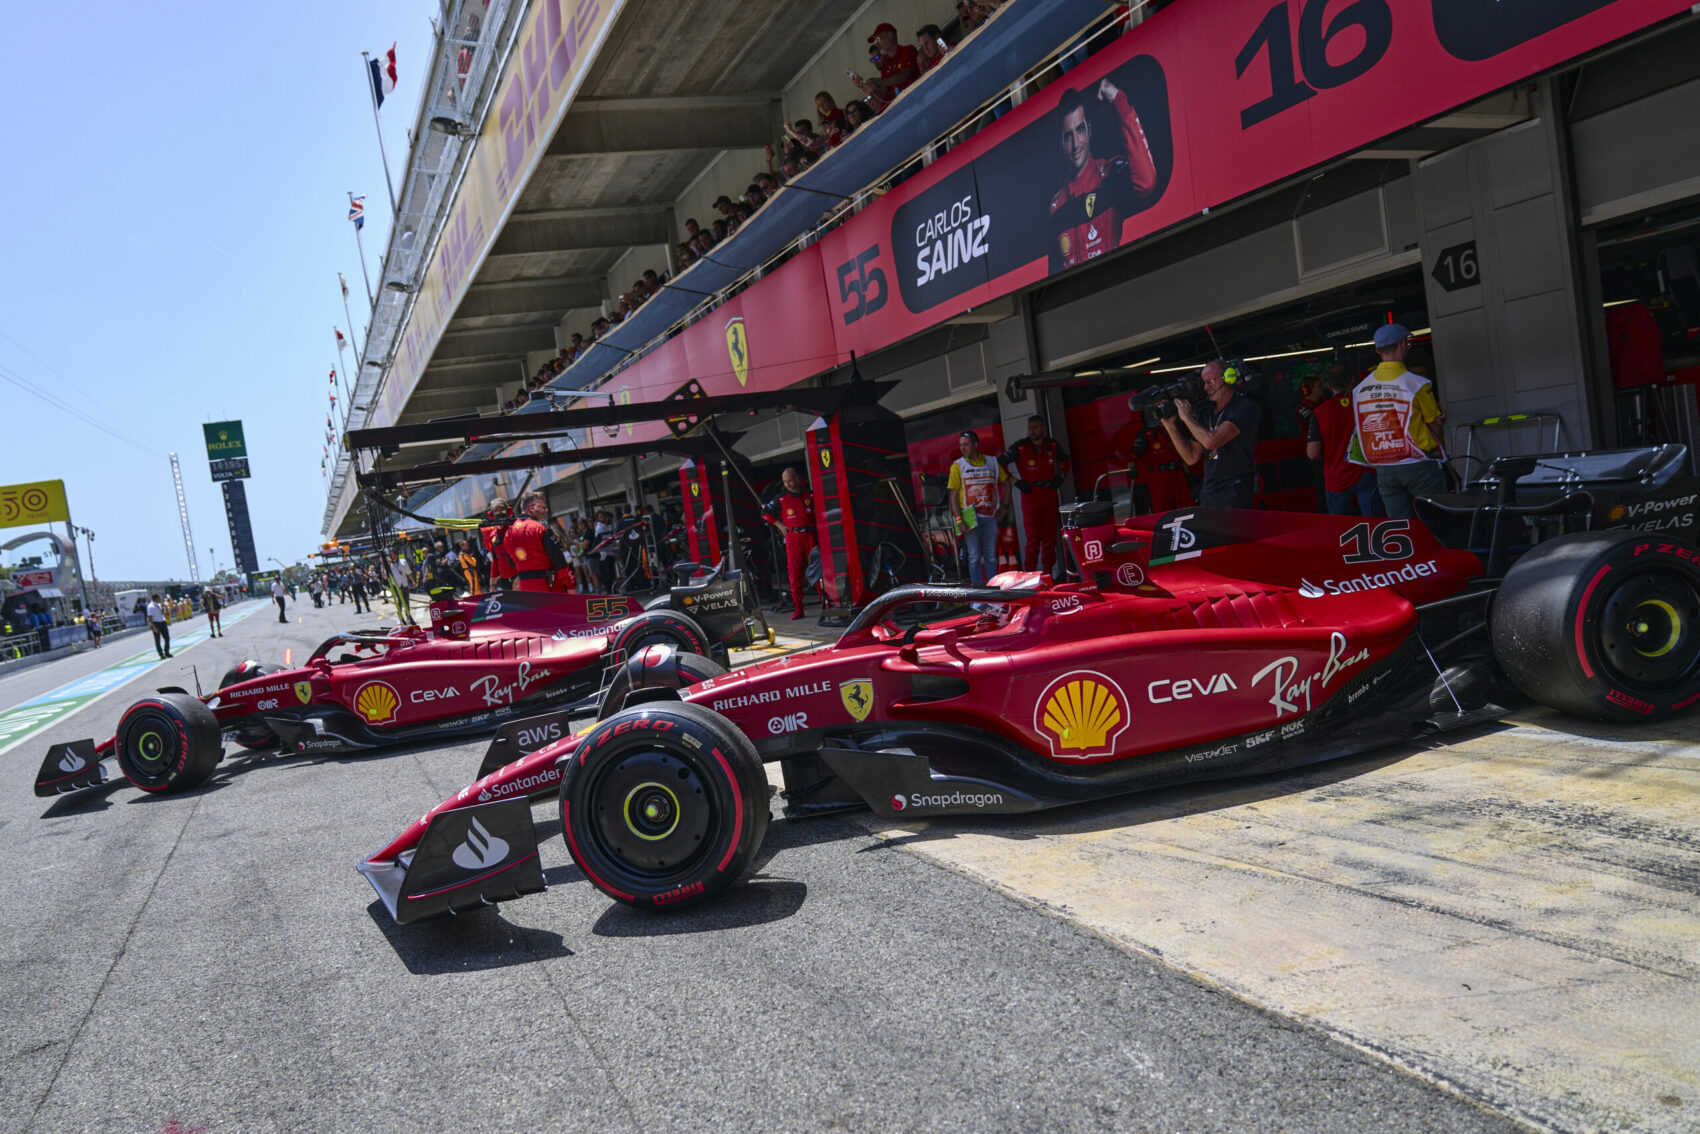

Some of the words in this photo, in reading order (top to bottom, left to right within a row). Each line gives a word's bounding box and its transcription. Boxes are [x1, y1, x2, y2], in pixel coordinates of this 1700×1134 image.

[1235, 0, 1393, 130] 16
[916, 195, 971, 247] CARLOS
[917, 215, 990, 287] SAINZ
[1444, 250, 1477, 284] 16
[836, 242, 888, 326] 55
[208, 440, 242, 451] ROLEX
[1371, 438, 1405, 451] LANE
[1374, 431, 1396, 441] PIT
[213, 471, 233, 479] VOLTA
[1627, 493, 1698, 518] V-Power
[1340, 519, 1414, 564] 16
[1634, 543, 1650, 557] P
[1323, 559, 1438, 596] Santander
[693, 588, 734, 604] V-Power
[702, 598, 738, 611] VELAS
[1051, 595, 1080, 611] aws
[586, 596, 630, 623] 55
[470, 661, 551, 707] Ray-Ban
[1252, 631, 1370, 718] Ray-Ban
[230, 686, 265, 699] RICHARD
[266, 682, 290, 693] MILLE
[713, 689, 781, 712] RICHARD
[785, 680, 832, 699] MILLE
[1348, 683, 1370, 703] brembo
[306, 739, 342, 751] Snapdragon
[517, 722, 562, 747] aws
[579, 745, 591, 768] P
[597, 719, 675, 748] ZERO
[1245, 730, 1275, 749] SKF
[177, 730, 189, 772] ZERO
[490, 768, 561, 798] Santander
[911, 791, 1004, 808] Snapdragon
[652, 880, 705, 906] PIRELLI
